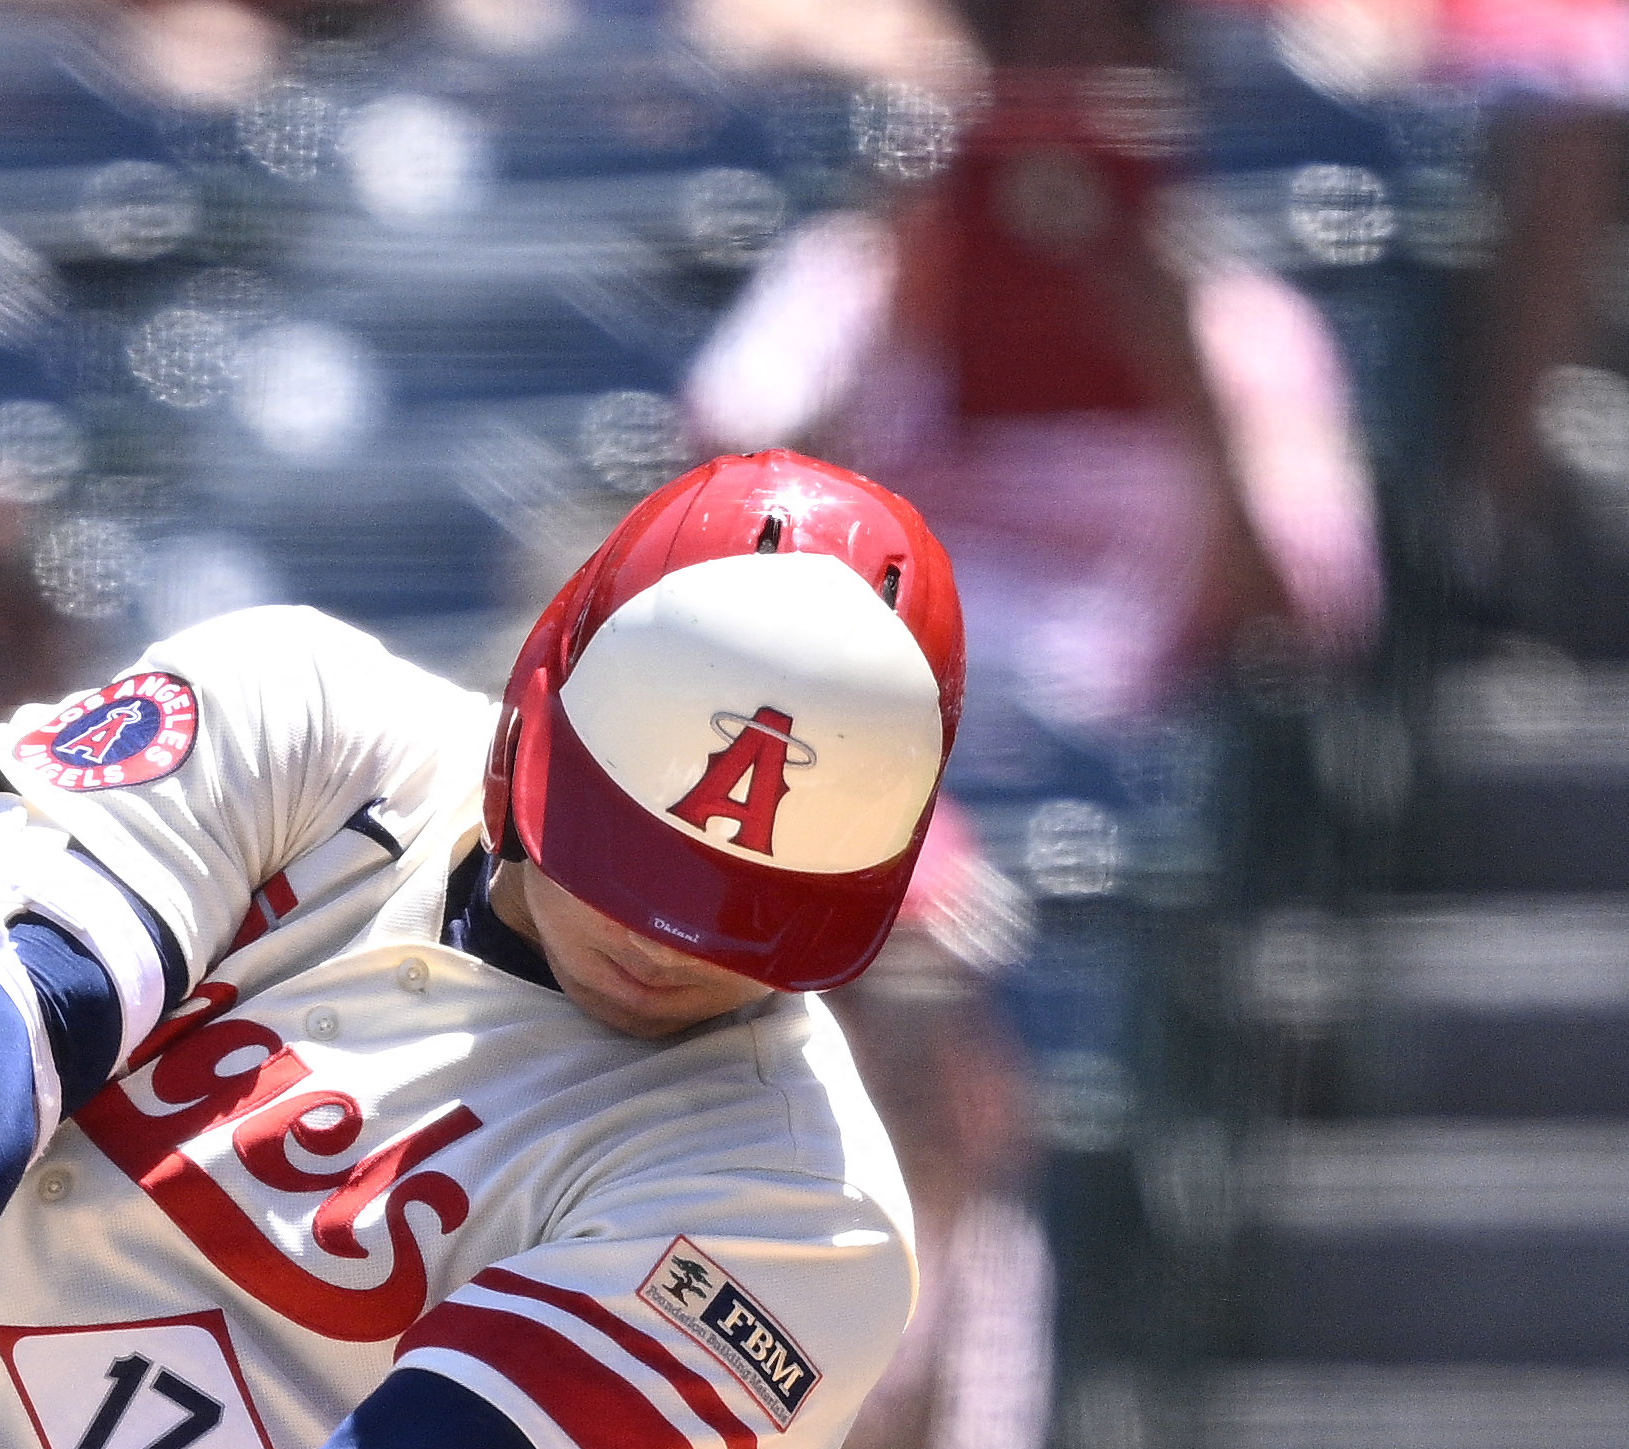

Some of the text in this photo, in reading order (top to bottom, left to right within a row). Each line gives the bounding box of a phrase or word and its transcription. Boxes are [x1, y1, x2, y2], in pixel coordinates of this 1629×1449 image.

[113, 675, 192, 767] ANGELES
[665, 706, 795, 858] A
[653, 917, 700, 943] Ohtani
[75, 870, 484, 1343] gels
[645, 1285, 789, 1424] Foundation Building Materials
[716, 1298, 805, 1398] FBM
